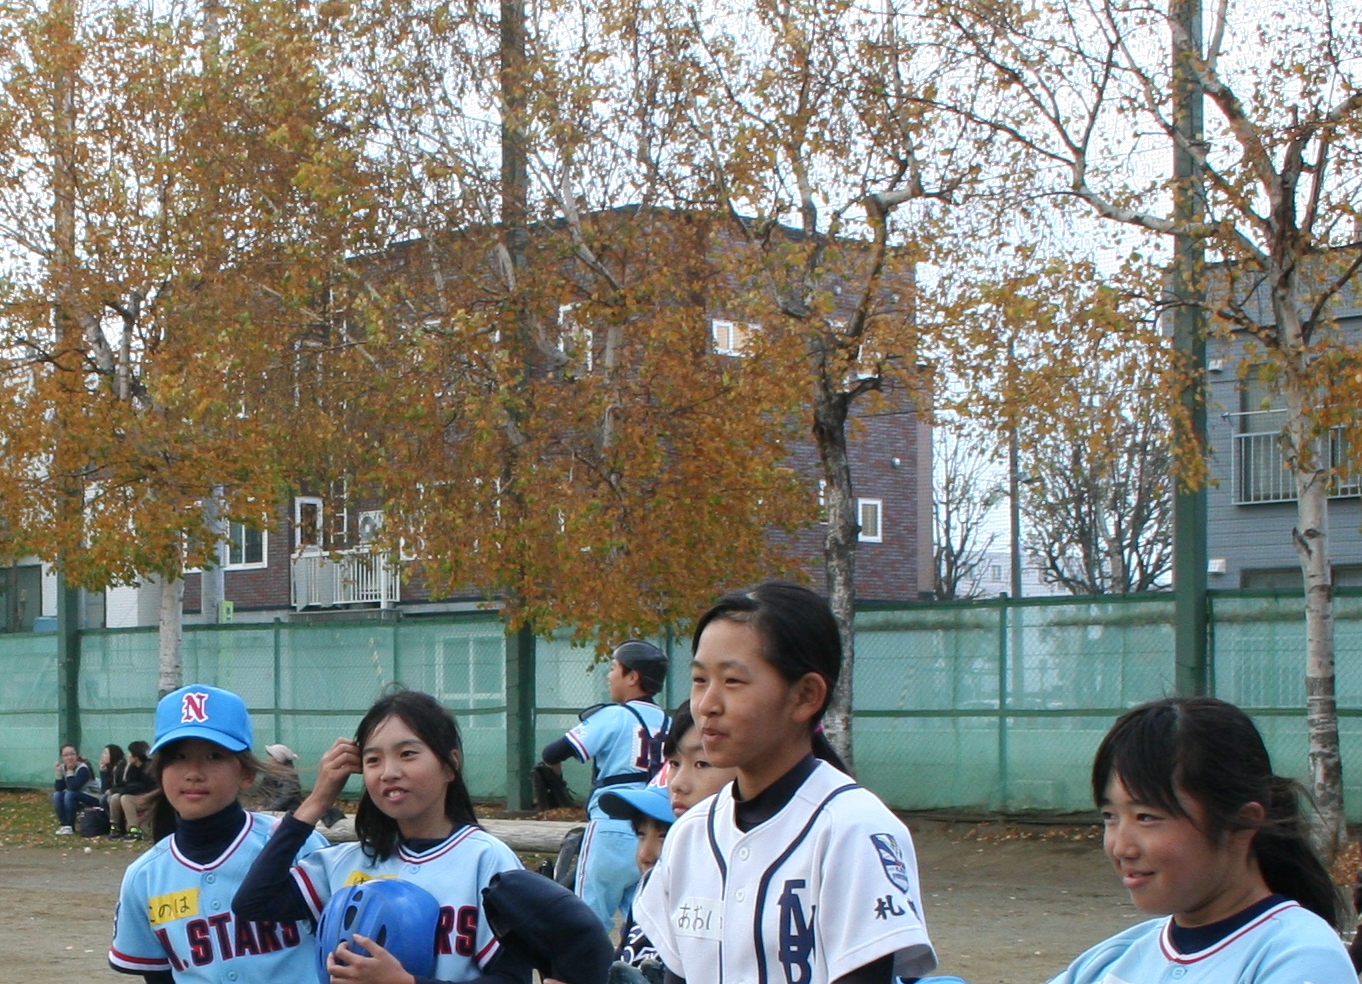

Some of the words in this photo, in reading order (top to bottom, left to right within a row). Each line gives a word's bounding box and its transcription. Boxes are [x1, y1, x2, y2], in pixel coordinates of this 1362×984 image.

[181, 692, 209, 723] N
[678, 903, 723, 932] あおい
